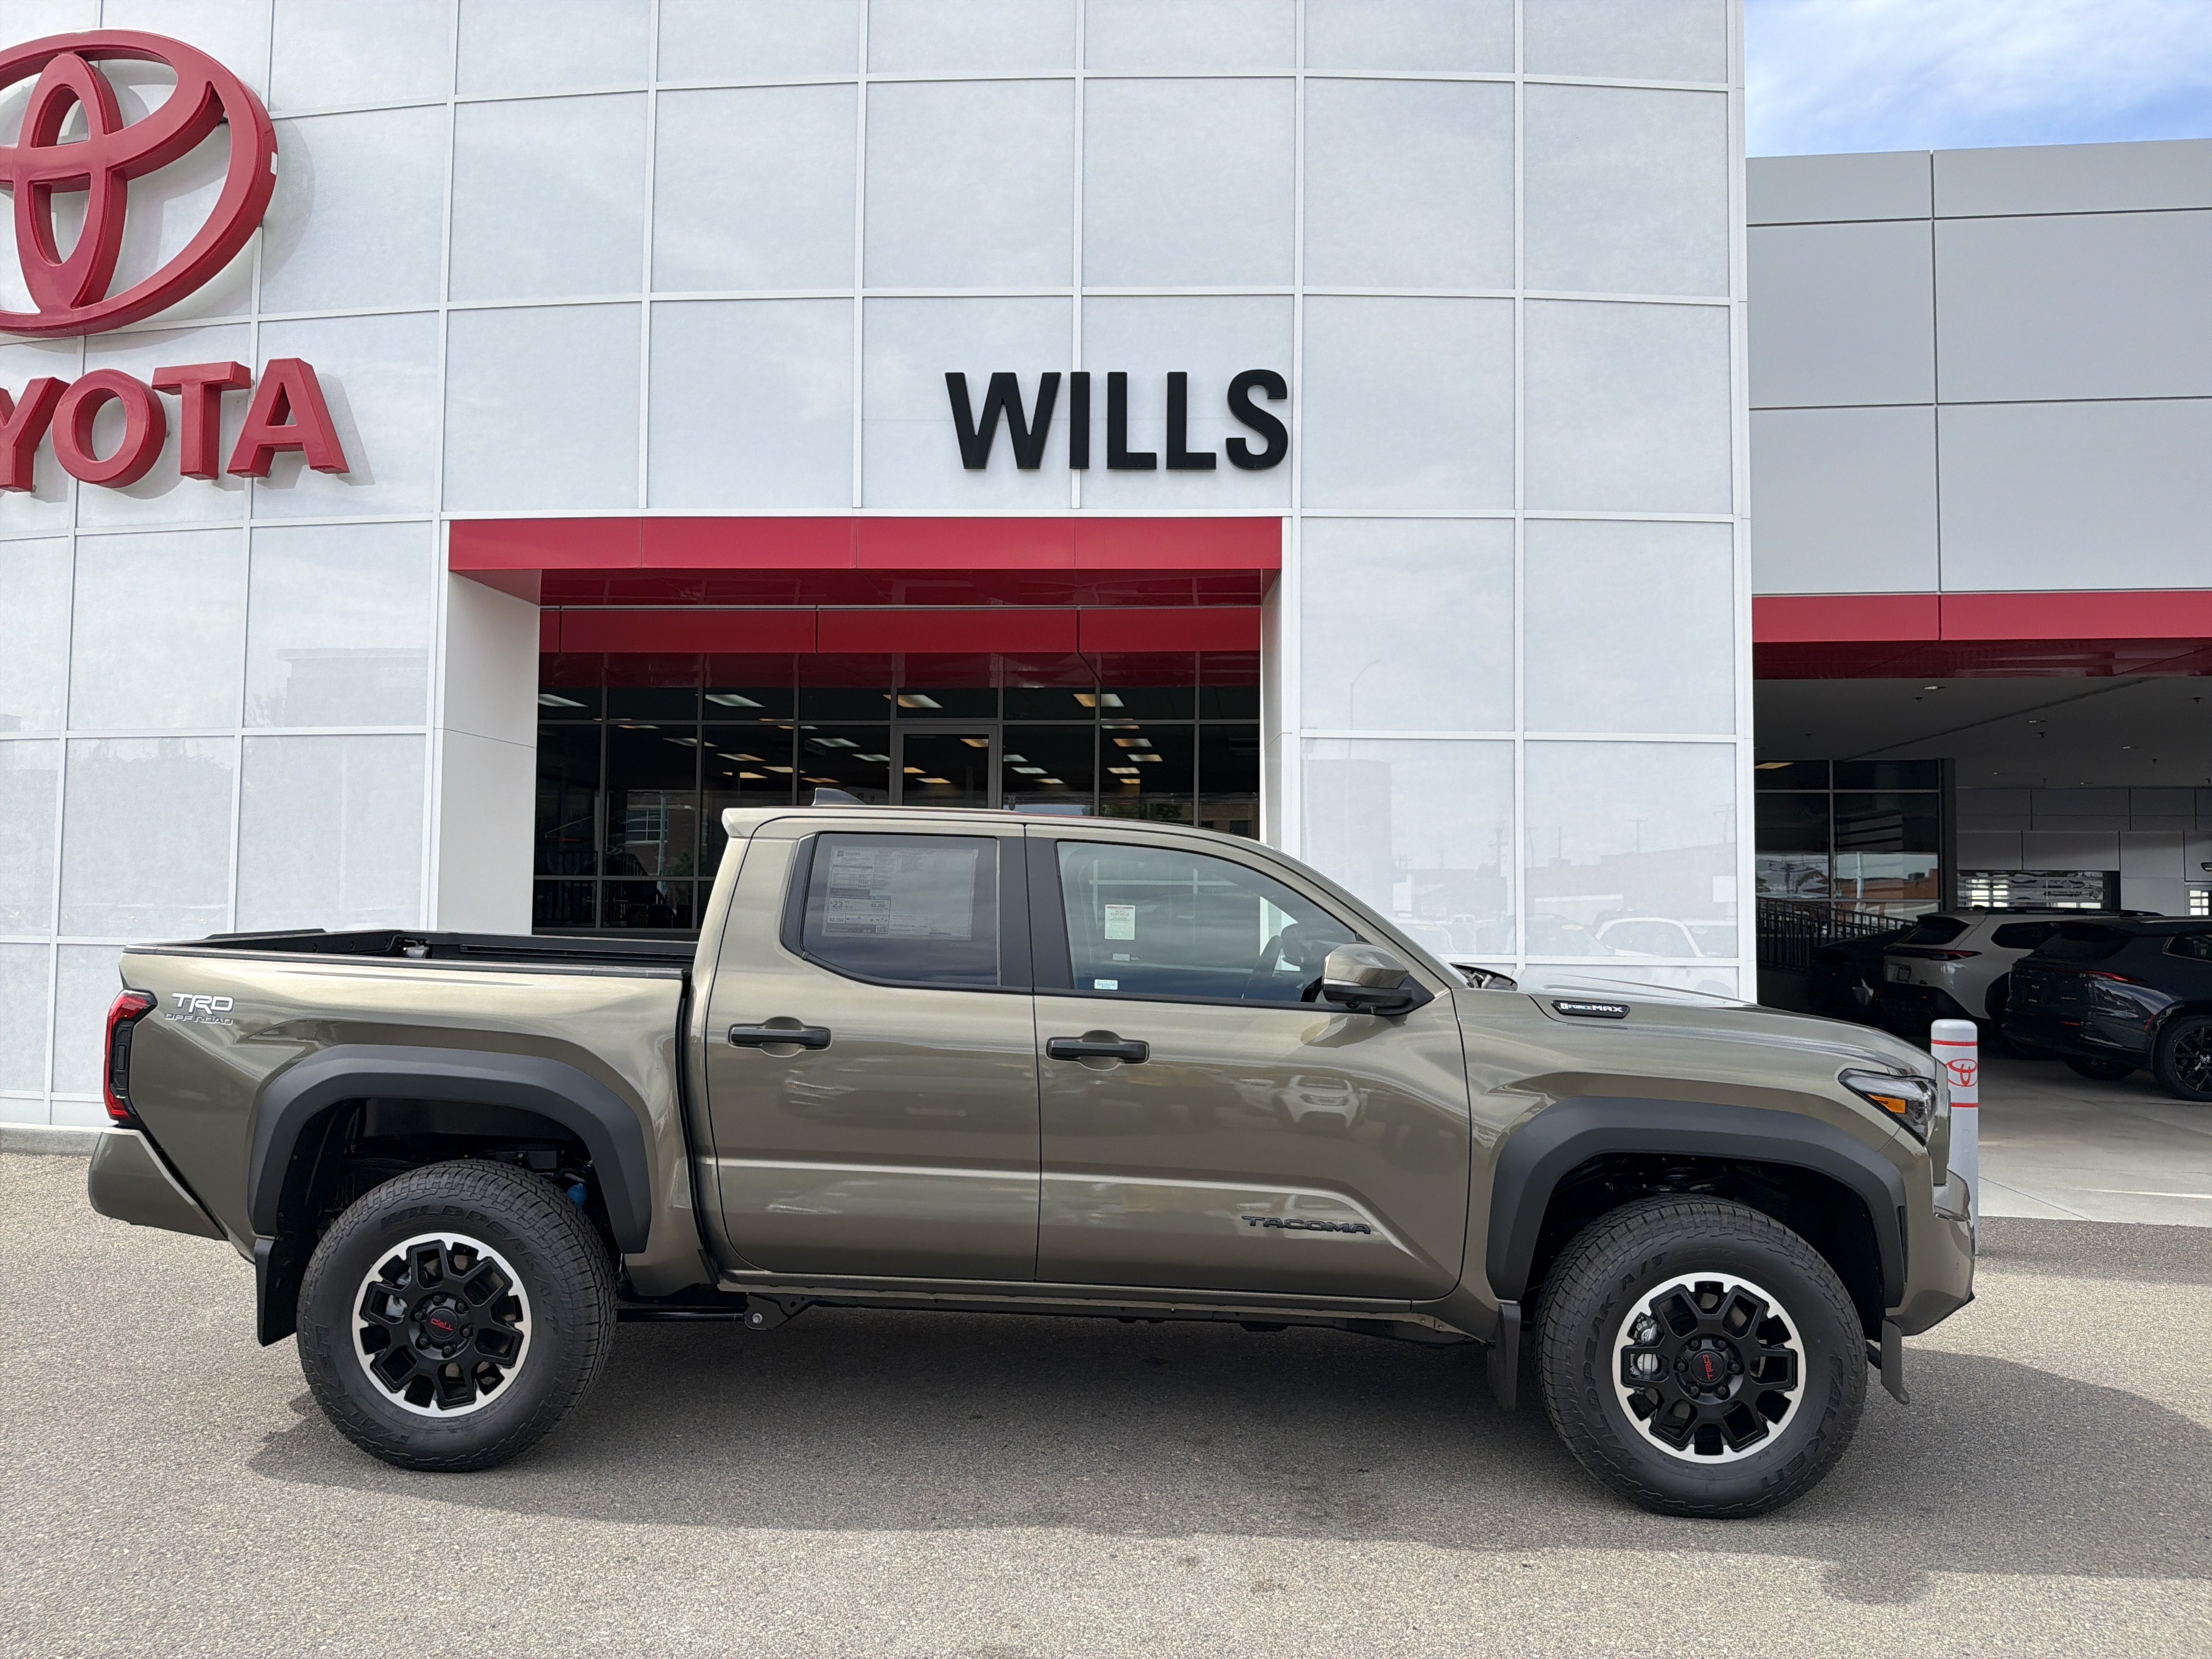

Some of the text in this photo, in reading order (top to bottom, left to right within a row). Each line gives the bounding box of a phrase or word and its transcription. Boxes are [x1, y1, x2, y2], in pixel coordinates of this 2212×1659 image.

[945, 369, 1288, 470] WILLS
[172, 992, 234, 1014] TRD
[1592, 1005, 1624, 1013] MAX
[164, 1013, 194, 1022] OFF
[1242, 1215, 1371, 1234] TACOMA
[381, 1205, 544, 1271] WILDPEAK
[1703, 1355, 1714, 1380] TRD
